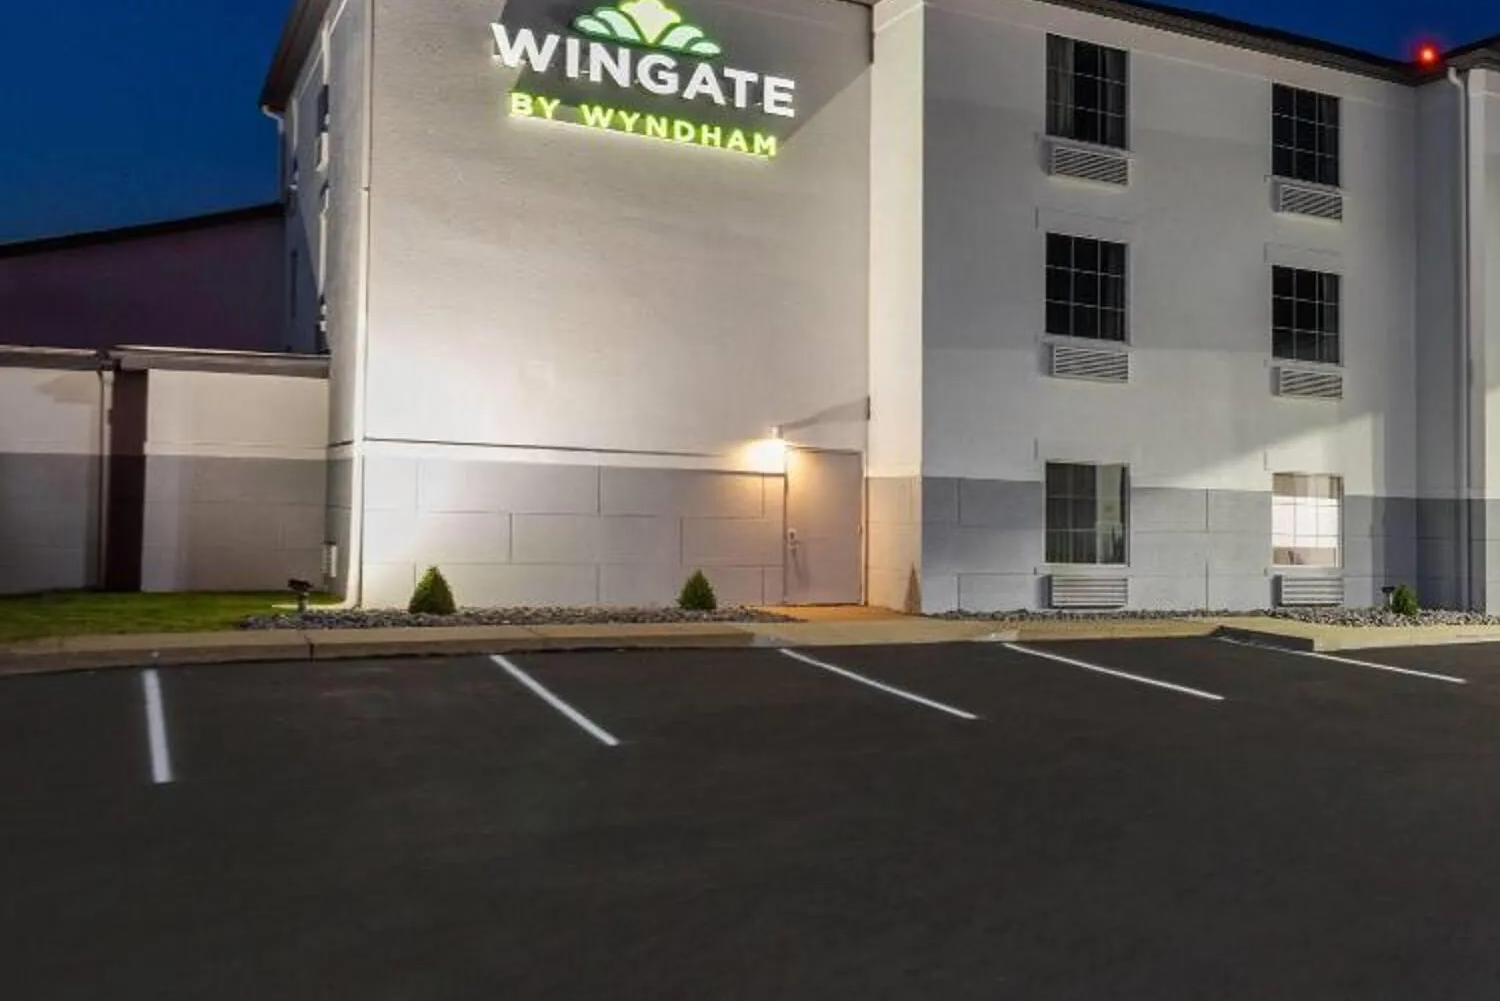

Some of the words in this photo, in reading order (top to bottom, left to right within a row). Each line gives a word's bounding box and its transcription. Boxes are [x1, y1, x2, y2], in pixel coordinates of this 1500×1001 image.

[490, 21, 796, 118] WINGATE
[509, 91, 561, 120] BY
[579, 102, 777, 157] WYNDHAM
